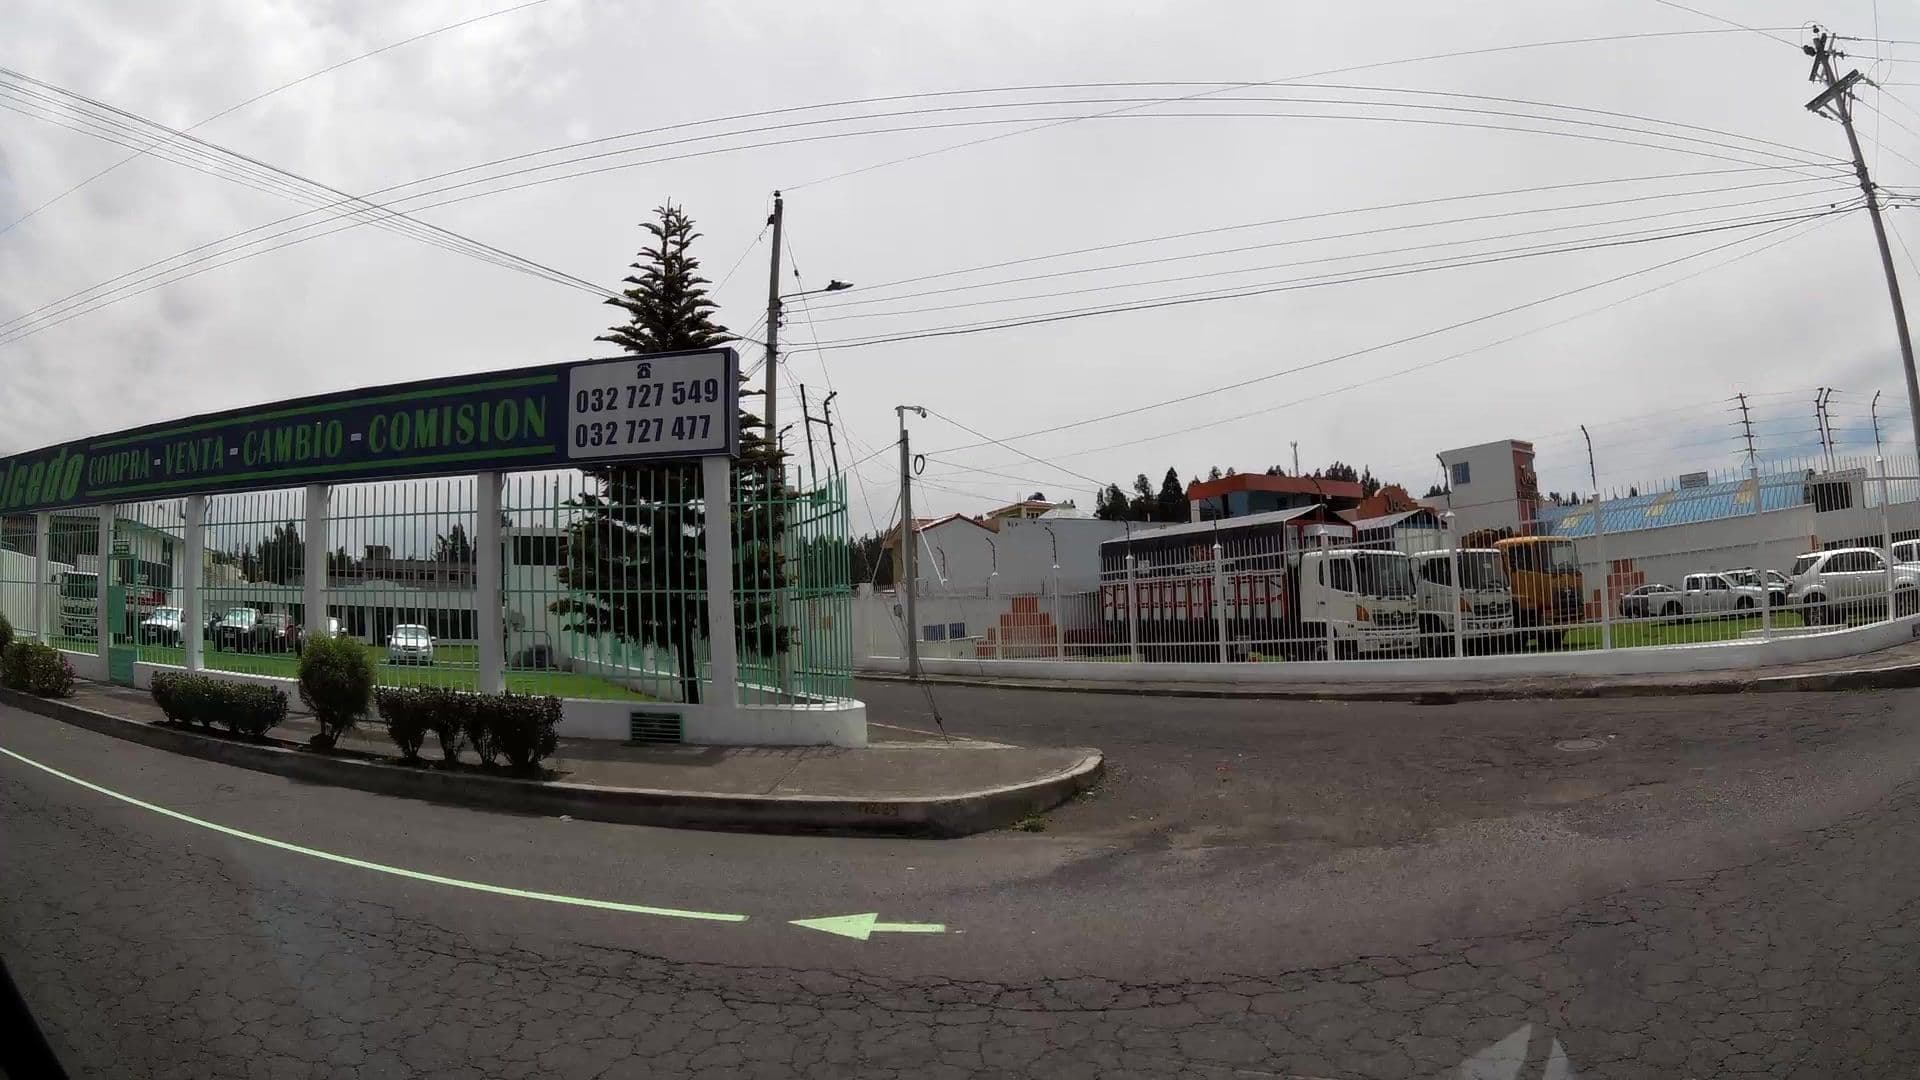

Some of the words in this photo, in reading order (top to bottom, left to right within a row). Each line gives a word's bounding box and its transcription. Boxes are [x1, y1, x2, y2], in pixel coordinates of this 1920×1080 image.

[576, 388, 618, 413] 032
[627, 383, 664, 408] 727
[672, 378, 718, 405] 549
[88, 448, 149, 486] COMPRA
[164, 435, 224, 475] VENTA
[243, 419, 343, 466] CAMBIO
[368, 396, 546, 453] COMISION
[575, 421, 618, 448] 032
[626, 418, 663, 444] 727
[672, 414, 711, 440] 477
[0, 447, 84, 508] lcedo
